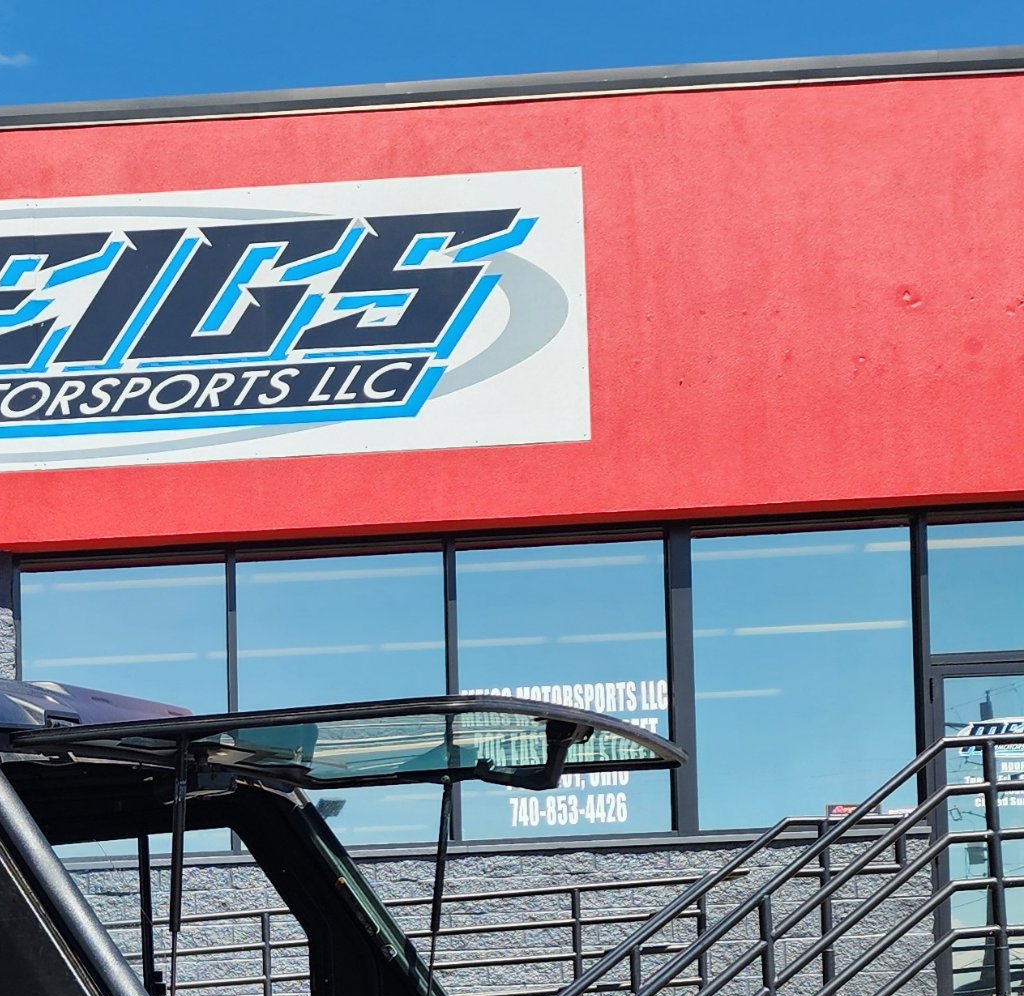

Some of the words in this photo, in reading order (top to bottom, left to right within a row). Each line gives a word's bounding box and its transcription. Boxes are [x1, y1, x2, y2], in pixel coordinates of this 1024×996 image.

[307, 361, 412, 401] LLC
[517, 681, 637, 714] MOTORSPORTS
[641, 680, 668, 711] LLC
[509, 792, 628, 827] 740-853-4426
